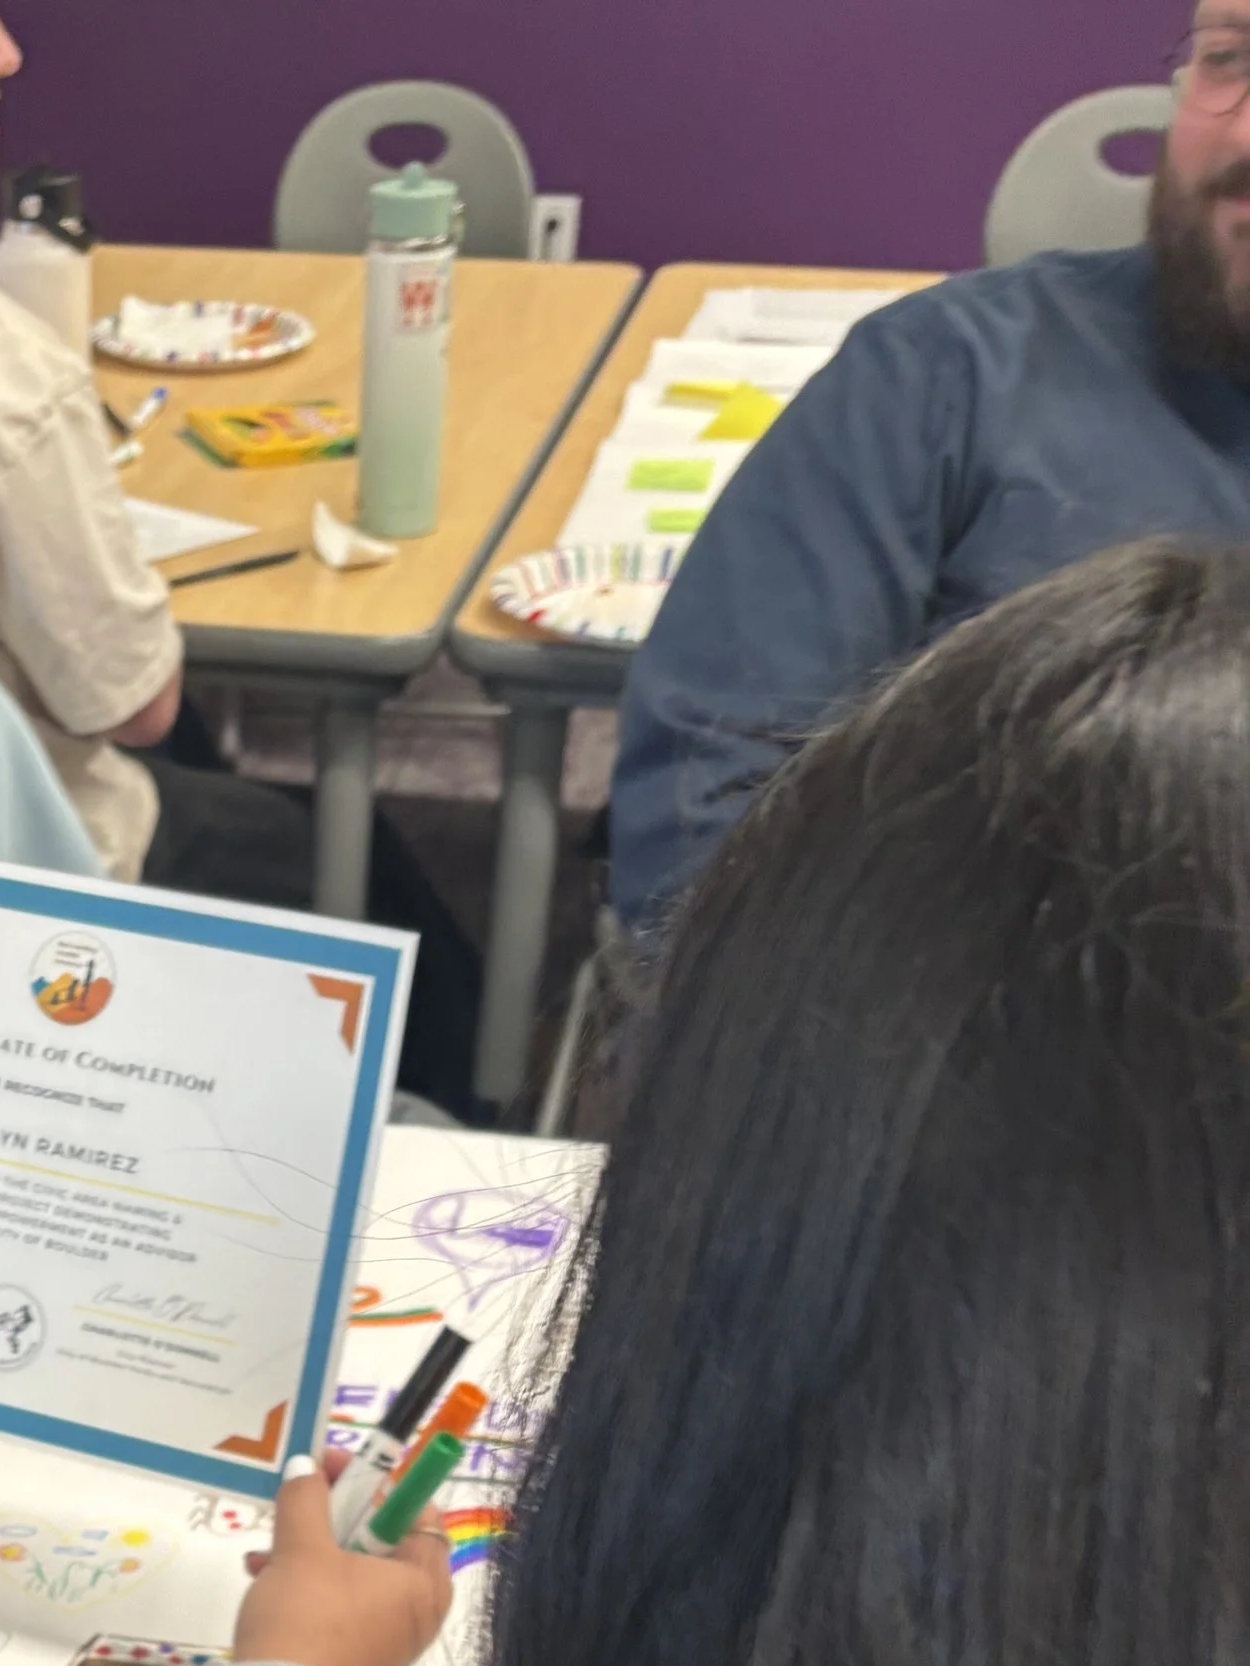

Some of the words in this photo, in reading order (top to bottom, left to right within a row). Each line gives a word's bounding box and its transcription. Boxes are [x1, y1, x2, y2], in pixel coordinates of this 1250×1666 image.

[41, 1046, 69, 1063] OF
[75, 1050, 216, 1093] COMPLETION
[4, 1079, 83, 1106] RECOGNIZE
[87, 1096, 126, 1114] THAT
[36, 1135, 142, 1174] RAMIREZ
[3, 1176, 29, 1189] THE
[32, 1183, 68, 1198] CIVIC
[53, 1205, 172, 1241] DEMONSTRATING
[23, 1233, 41, 1245] OF
[44, 1238, 109, 1261] BOULDER
